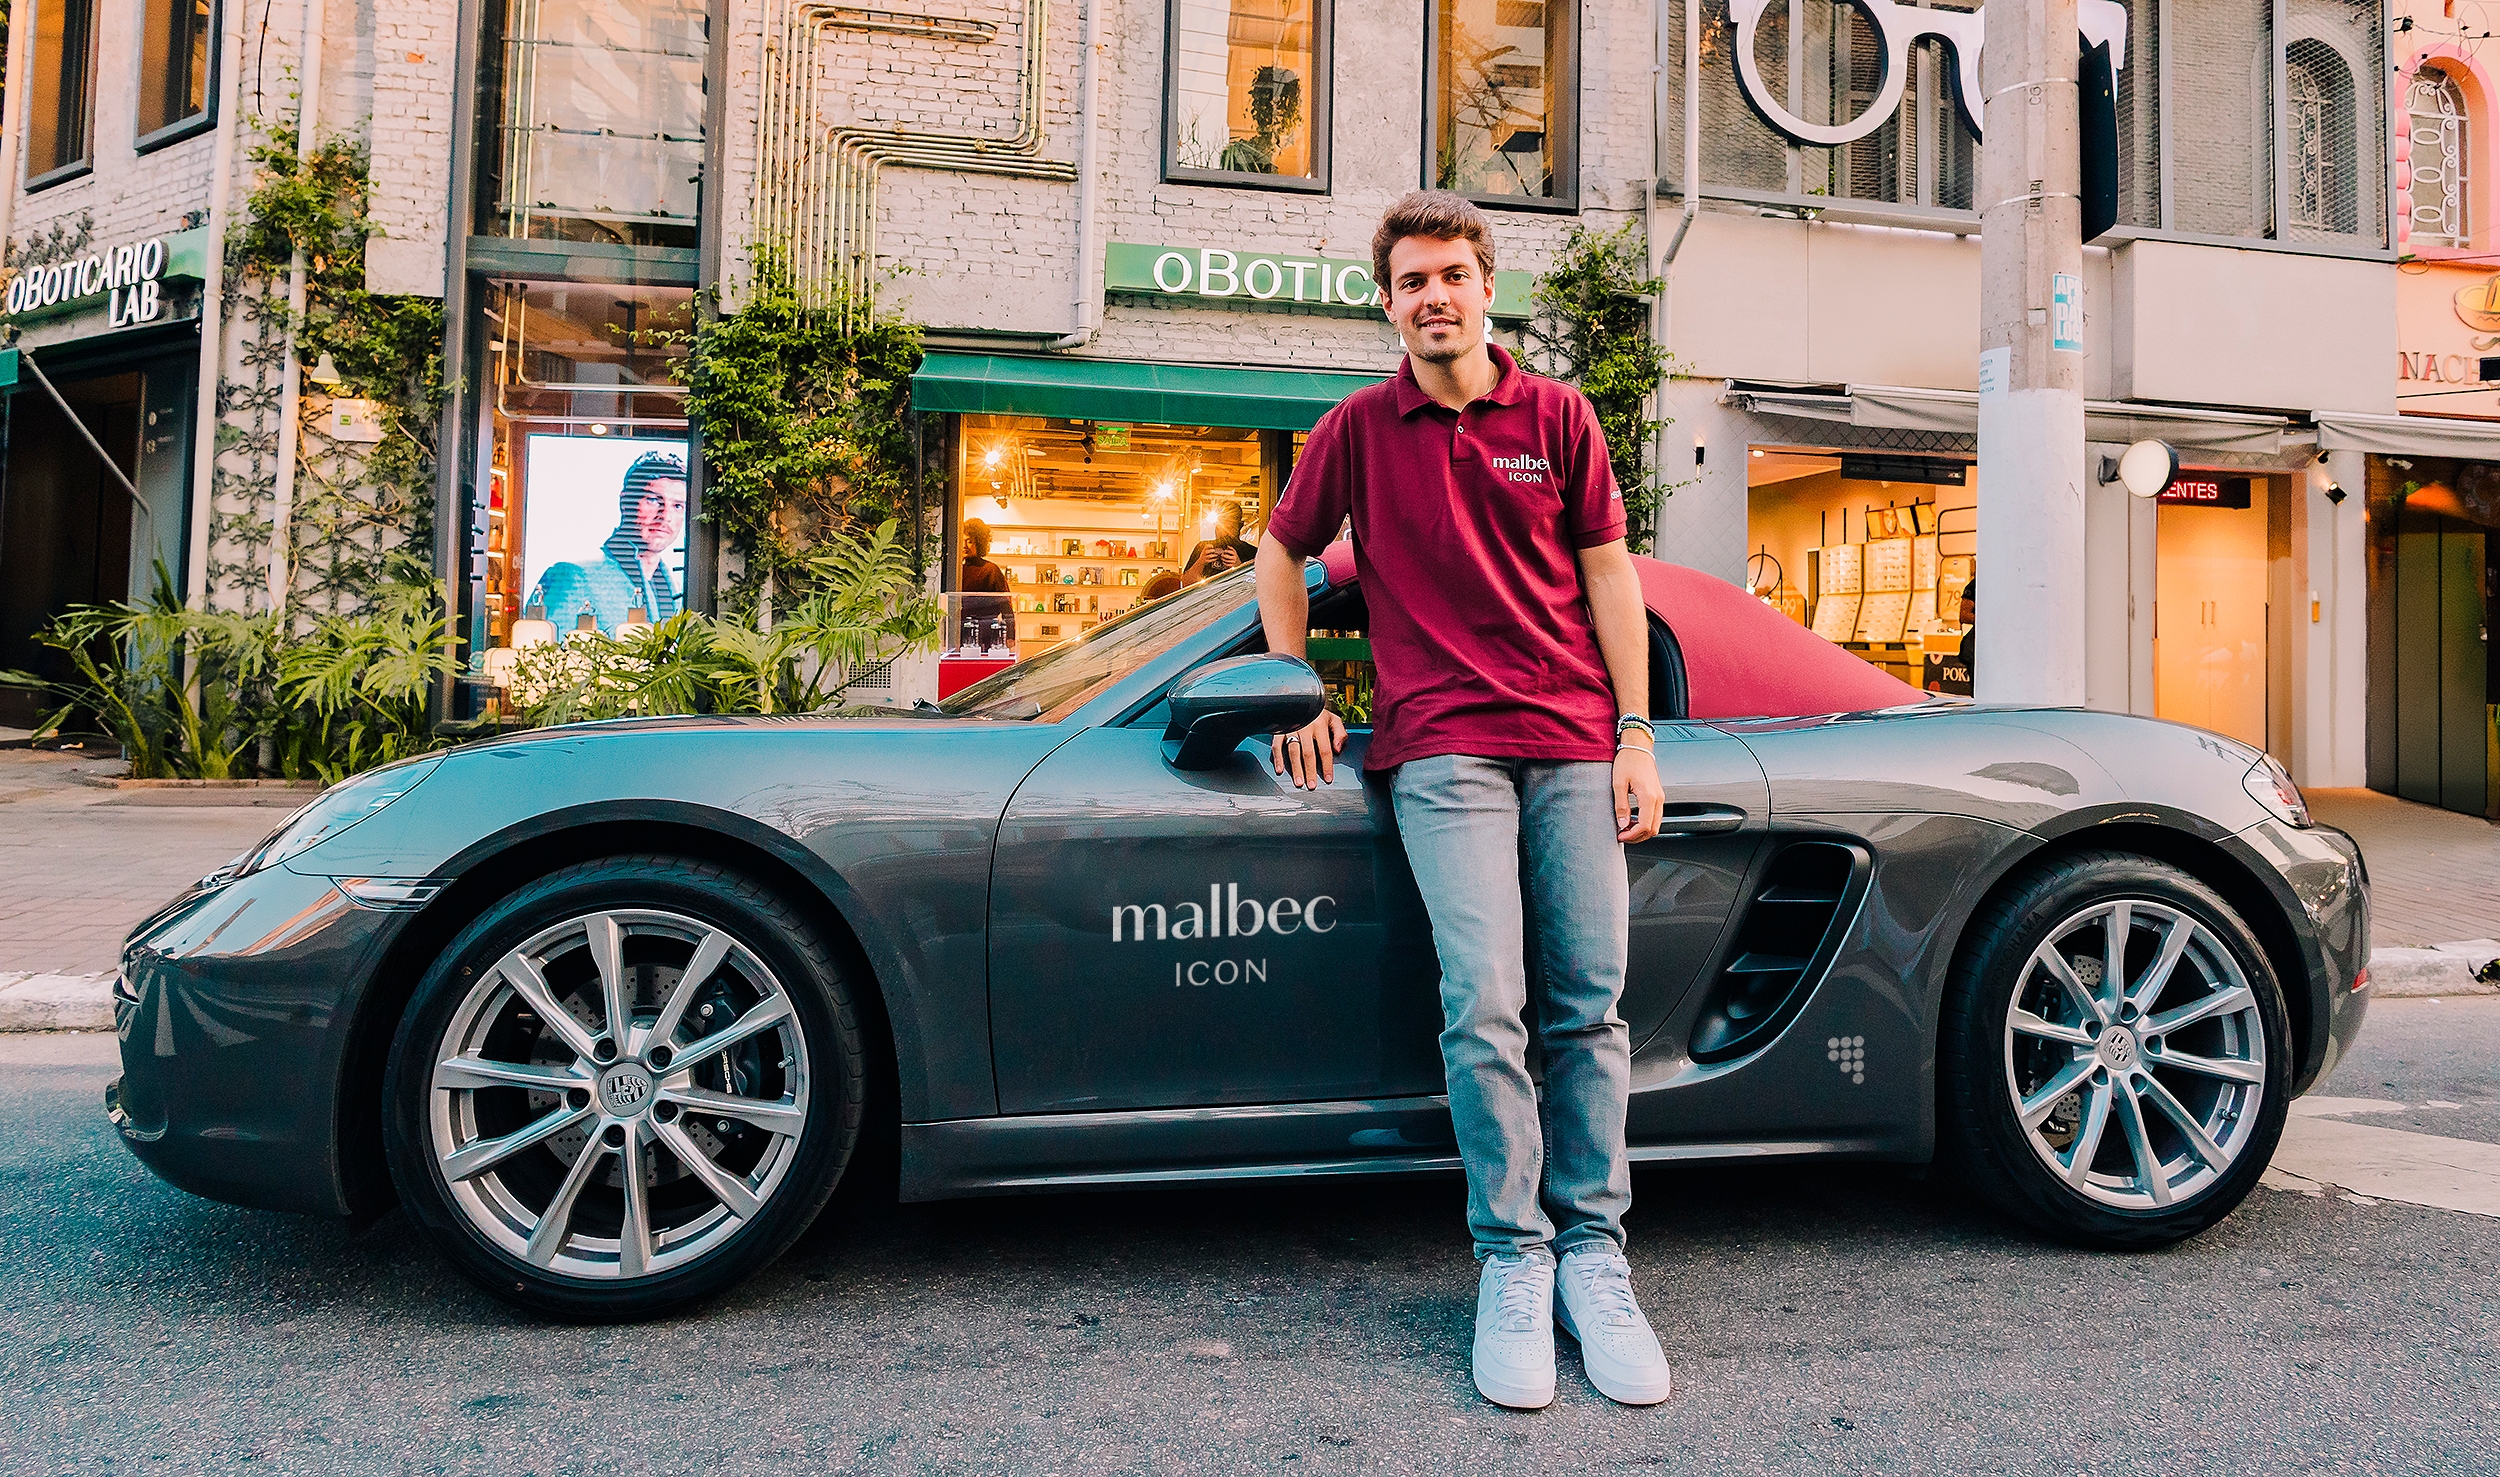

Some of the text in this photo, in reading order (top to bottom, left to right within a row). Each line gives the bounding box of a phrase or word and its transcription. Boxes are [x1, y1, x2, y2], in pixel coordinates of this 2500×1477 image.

[109, 280, 159, 328] LAB
[2399, 351, 2485, 386] NACH
[1508, 472, 1542, 484] ICON
[2162, 481, 2218, 500] ENTES
[1942, 666, 1970, 682] POK
[1112, 882, 1337, 942] malbec
[1175, 957, 1267, 987] ICON
